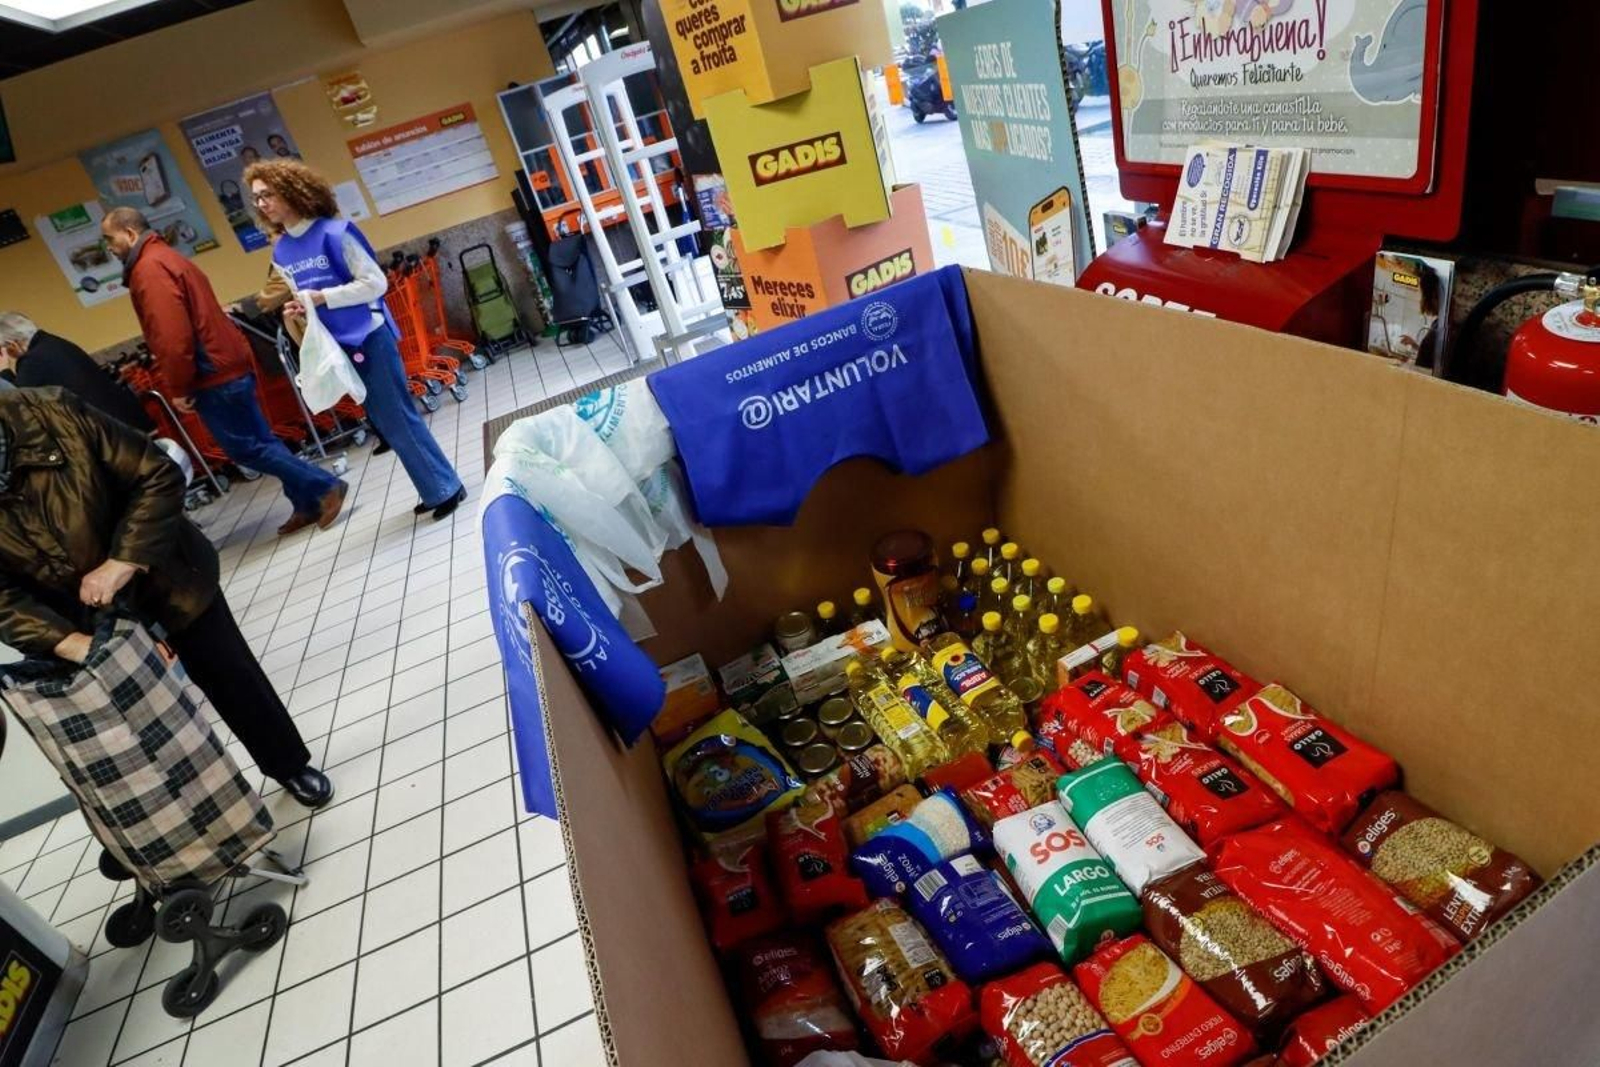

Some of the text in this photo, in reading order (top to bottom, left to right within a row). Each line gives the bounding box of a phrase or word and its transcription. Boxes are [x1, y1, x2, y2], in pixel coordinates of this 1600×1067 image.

[676, 5, 720, 39] queres
[692, 14, 746, 50] comprar
[691, 44, 738, 75] a froita
[1189, 61, 1303, 89] Queremos Felicitarte
[1002, 83, 1051, 121] CLIENTES
[1241, 101, 1261, 116] una
[1263, 96, 1321, 115] canastilla
[195, 127, 237, 146] ALIMENTA
[381, 134, 393, 146] de
[1225, 119, 1251, 135] para
[1261, 119, 1269, 136] y
[1271, 119, 1300, 135] para
[199, 137, 242, 156] UNA VIDA
[755, 137, 841, 177] GADIS
[1212, 216, 1224, 245] GRAN
[752, 275, 815, 299] Mereces
[851, 252, 914, 296] GADIS
[1393, 273, 1418, 286] GADIS
[771, 297, 806, 320] elixir
[725, 324, 857, 384] BANCOS DE ALIMENTOS
[738, 344, 908, 429] VOLUNTARI@
[960, 672, 987, 691] ABRIL
[1198, 670, 1222, 685] GALLO
[1293, 729, 1324, 751] GALLO
[1202, 767, 1229, 785] GALLO
[1365, 809, 1397, 842] eliges
[1030, 829, 1086, 865] SOS
[1145, 833, 1165, 847] SOS
[1054, 865, 1110, 897] LARGO
[997, 925, 1022, 941] eliges
[1320, 950, 1356, 988] eliges
[1201, 1015, 1224, 1033] FIDEO
[1161, 1028, 1203, 1060] ENTREFINO
[1194, 1032, 1224, 1060] eliges
